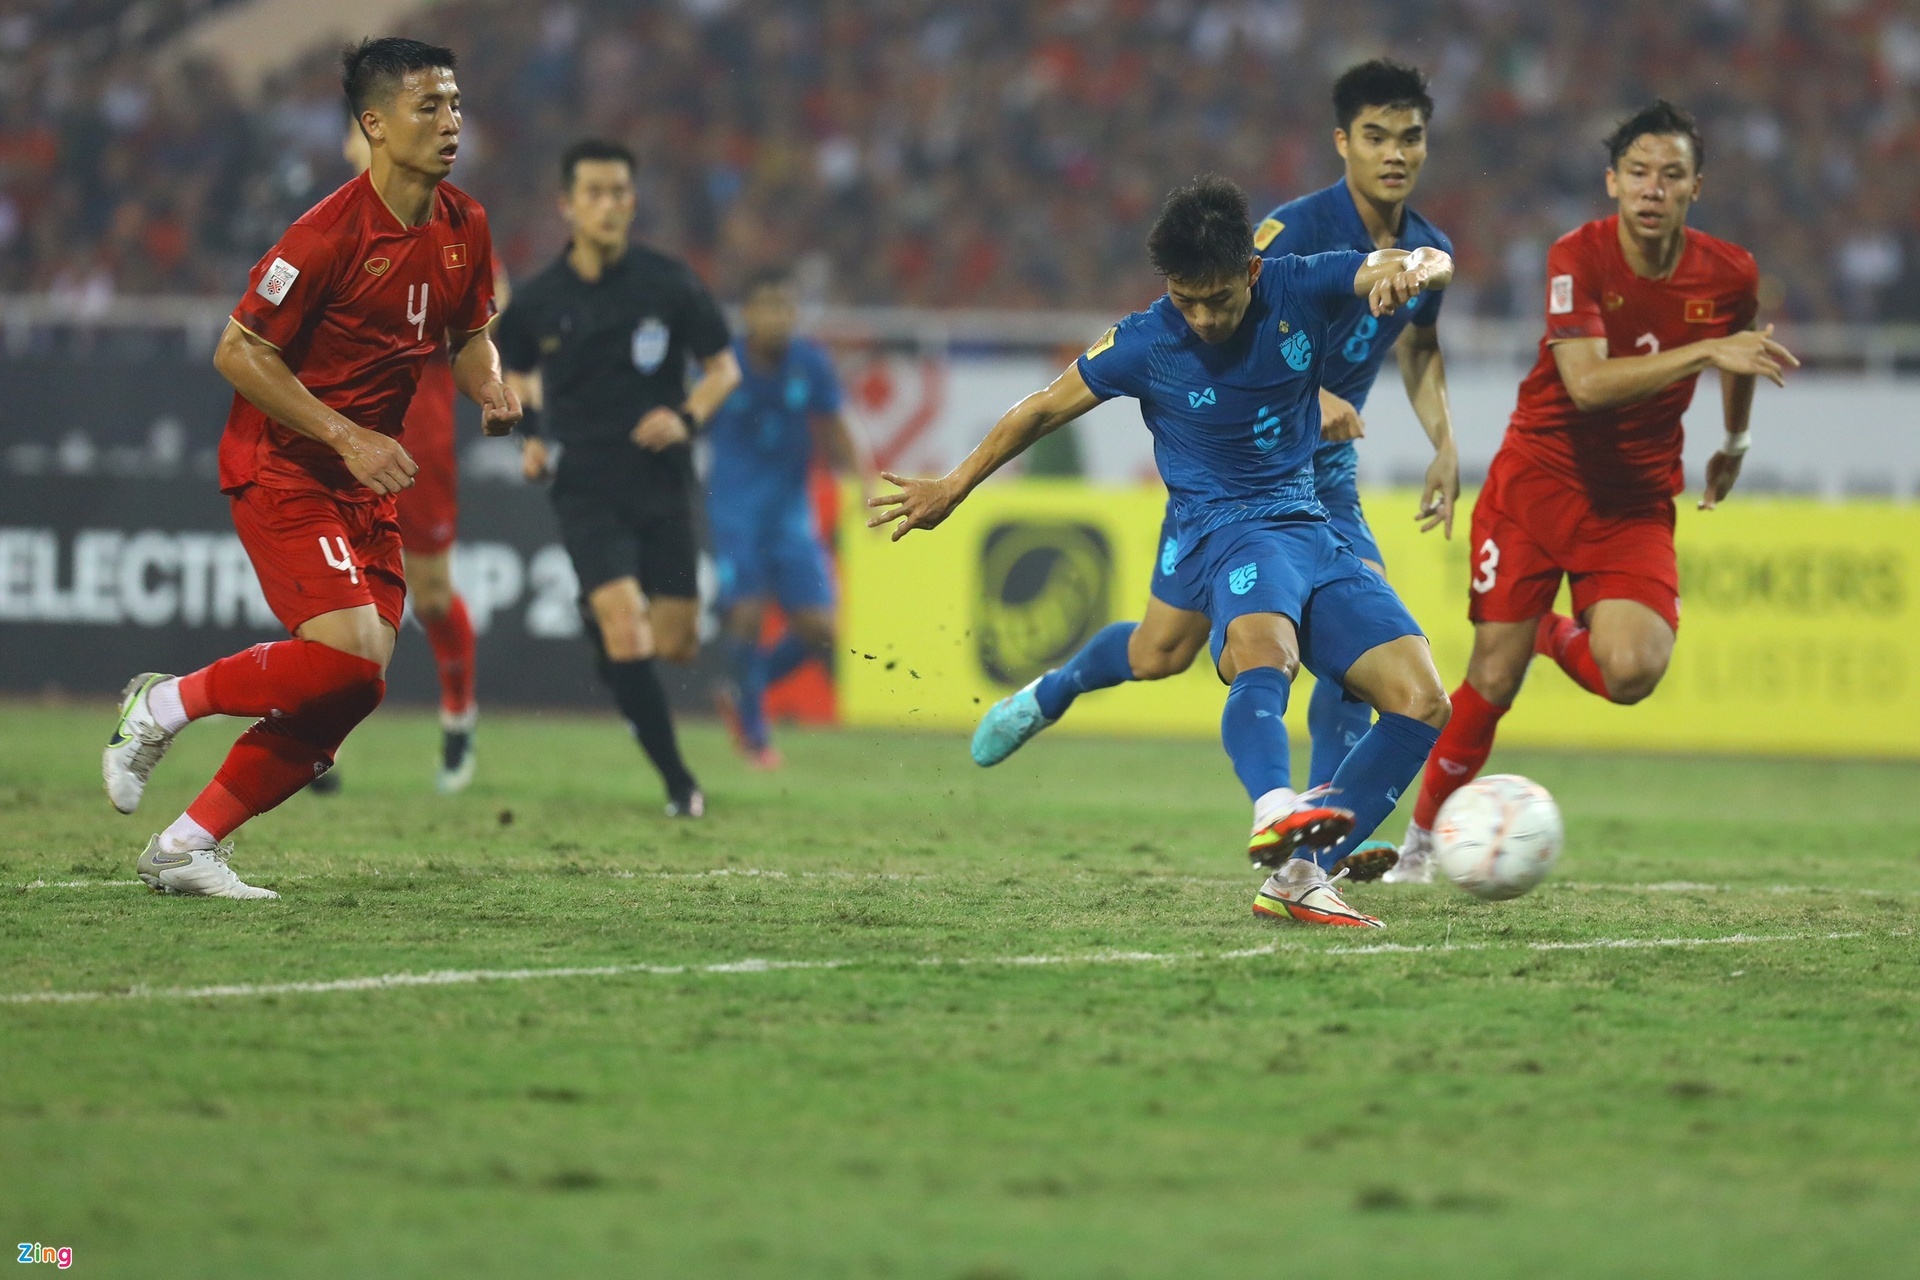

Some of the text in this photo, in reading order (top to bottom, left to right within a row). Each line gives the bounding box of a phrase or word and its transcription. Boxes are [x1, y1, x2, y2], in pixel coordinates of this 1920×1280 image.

[407, 282, 429, 341] 4
[1342, 314, 1379, 364] 8
[1252, 405, 1282, 451] 6
[0, 529, 287, 628] ELECTR
[318, 535, 360, 585] 4
[1472, 538, 1500, 594] 3
